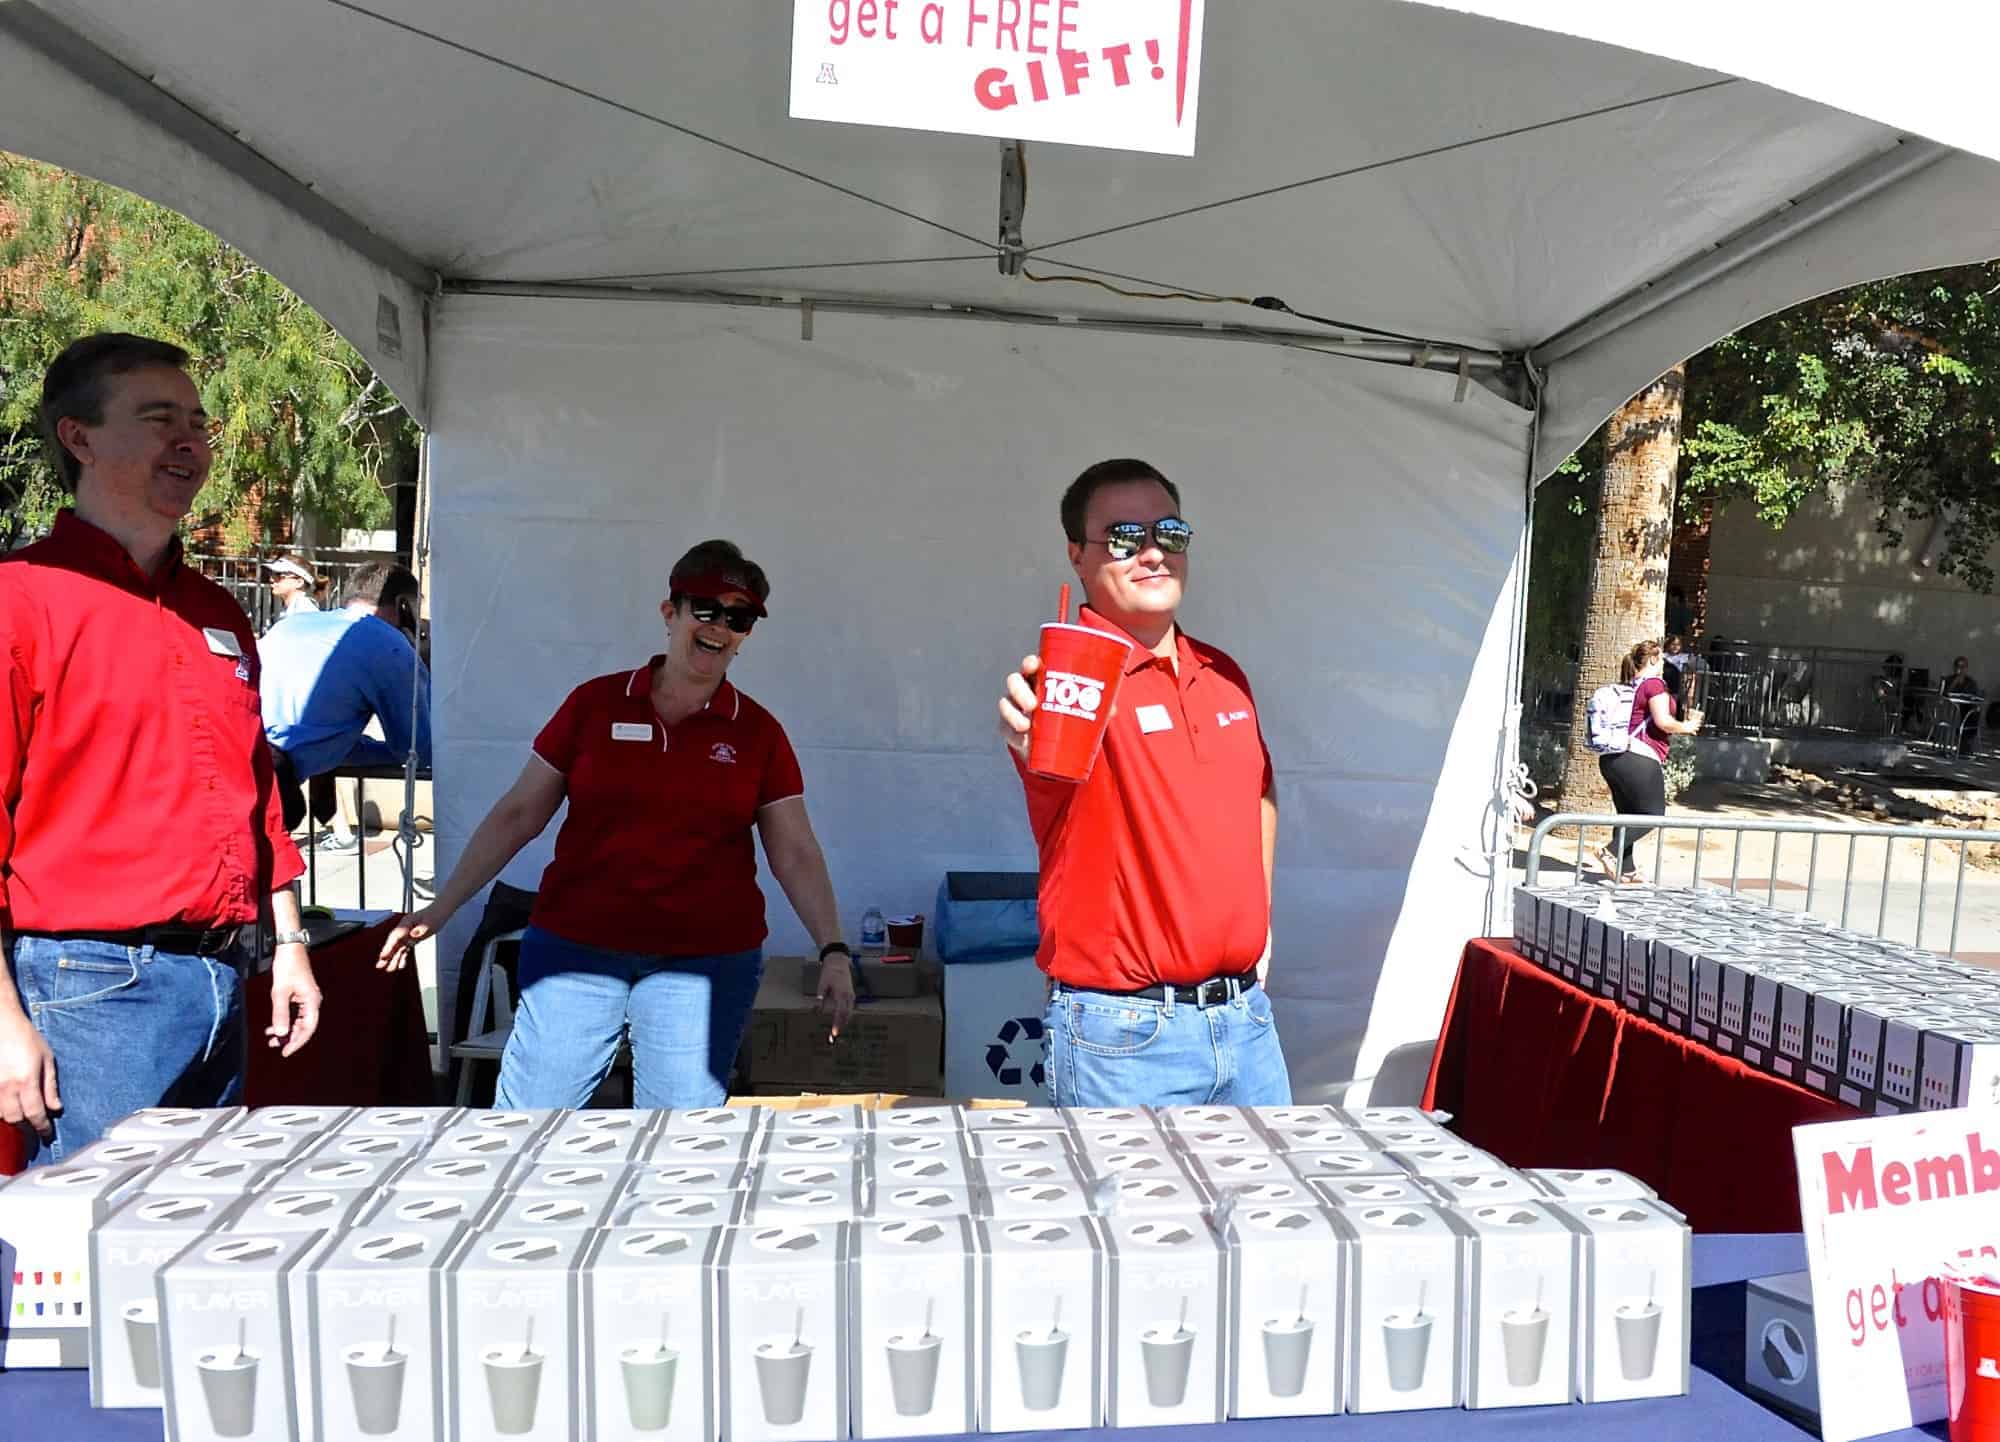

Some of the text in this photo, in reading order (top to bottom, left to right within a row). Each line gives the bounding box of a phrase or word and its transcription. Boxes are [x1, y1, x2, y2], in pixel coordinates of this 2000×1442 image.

[828, 0, 1078, 54] get a FREE
[974, 39, 1164, 111] GIFT!
[1846, 1267, 1907, 1346] get
